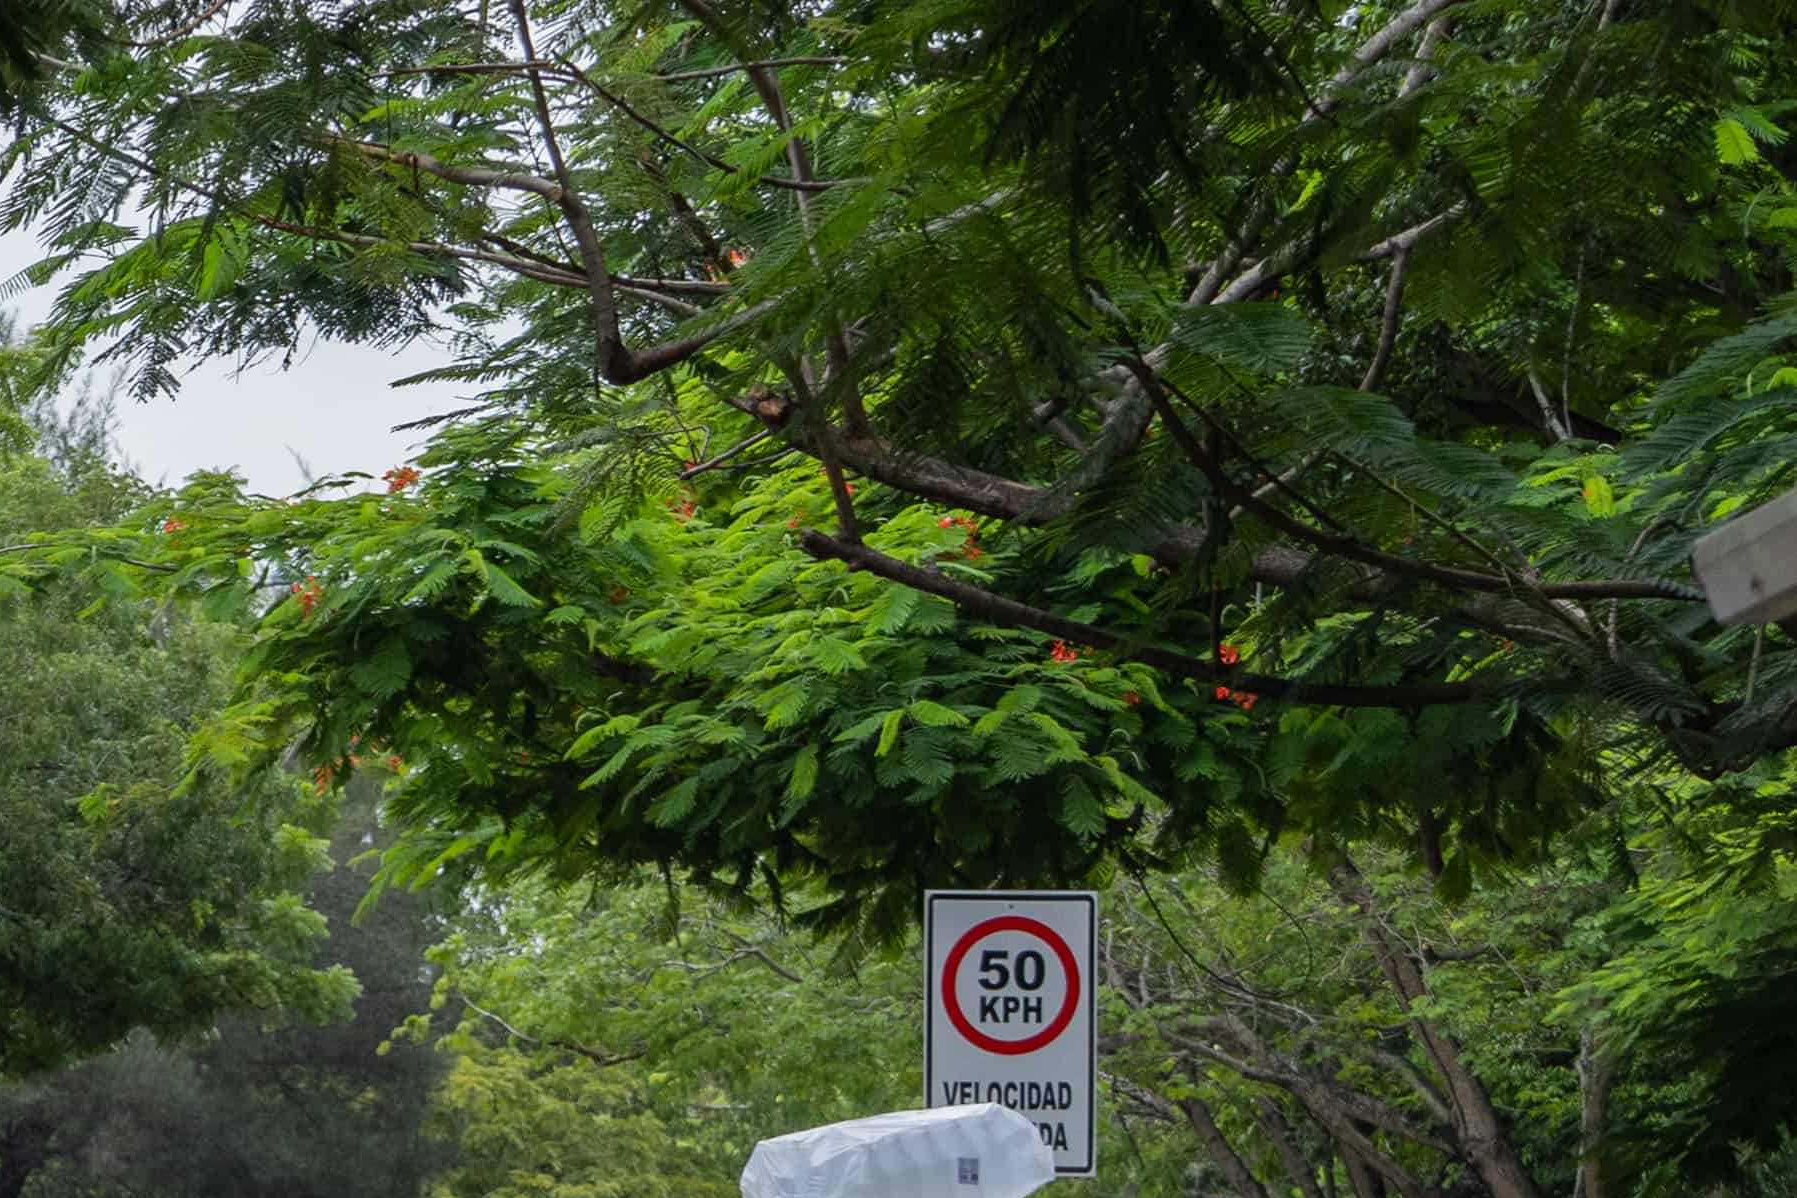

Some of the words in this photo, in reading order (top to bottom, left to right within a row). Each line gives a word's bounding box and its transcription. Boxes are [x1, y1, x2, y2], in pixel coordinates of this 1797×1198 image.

[978, 950, 1045, 991] 50
[980, 996, 1042, 1023] KPH
[943, 1081, 1072, 1111] VELOCIDAD
